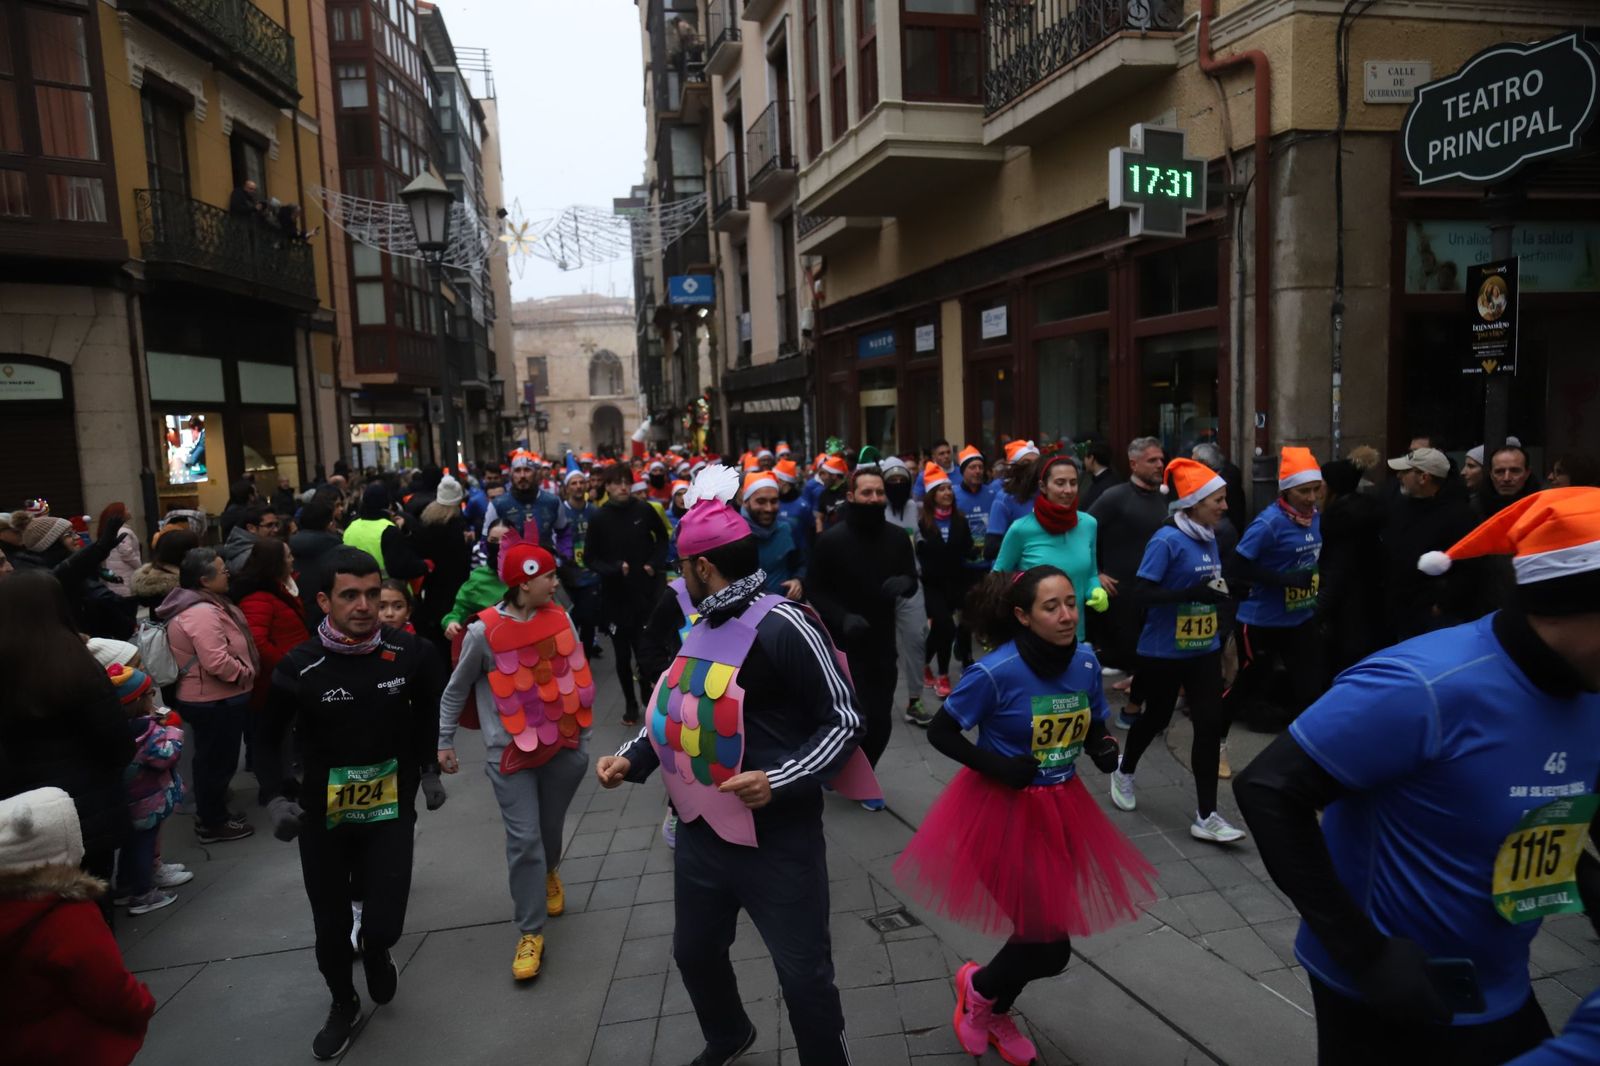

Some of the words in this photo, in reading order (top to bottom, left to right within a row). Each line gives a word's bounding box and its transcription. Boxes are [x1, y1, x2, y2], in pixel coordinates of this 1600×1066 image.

[1388, 66, 1416, 76] CALLE
[1393, 78, 1405, 87] DE
[1442, 69, 1543, 122] TEATRO
[1428, 106, 1562, 164] PRINCIPAL
[1129, 165, 1193, 198] 17:31
[1448, 232, 1464, 245] Un
[1522, 229, 1535, 245] la
[1537, 229, 1574, 245] salud
[1475, 250, 1489, 263] de
[1181, 616, 1213, 635] 413
[1036, 713, 1085, 746] 376
[1543, 752, 1567, 774] 46
[335, 780, 383, 807] 1124
[1509, 786, 1528, 797] SAN
[1529, 784, 1568, 797] SILVESTRE
[345, 812, 366, 820] CAJA
[367, 807, 395, 819] RURAL
[1511, 829, 1567, 881] 1115
